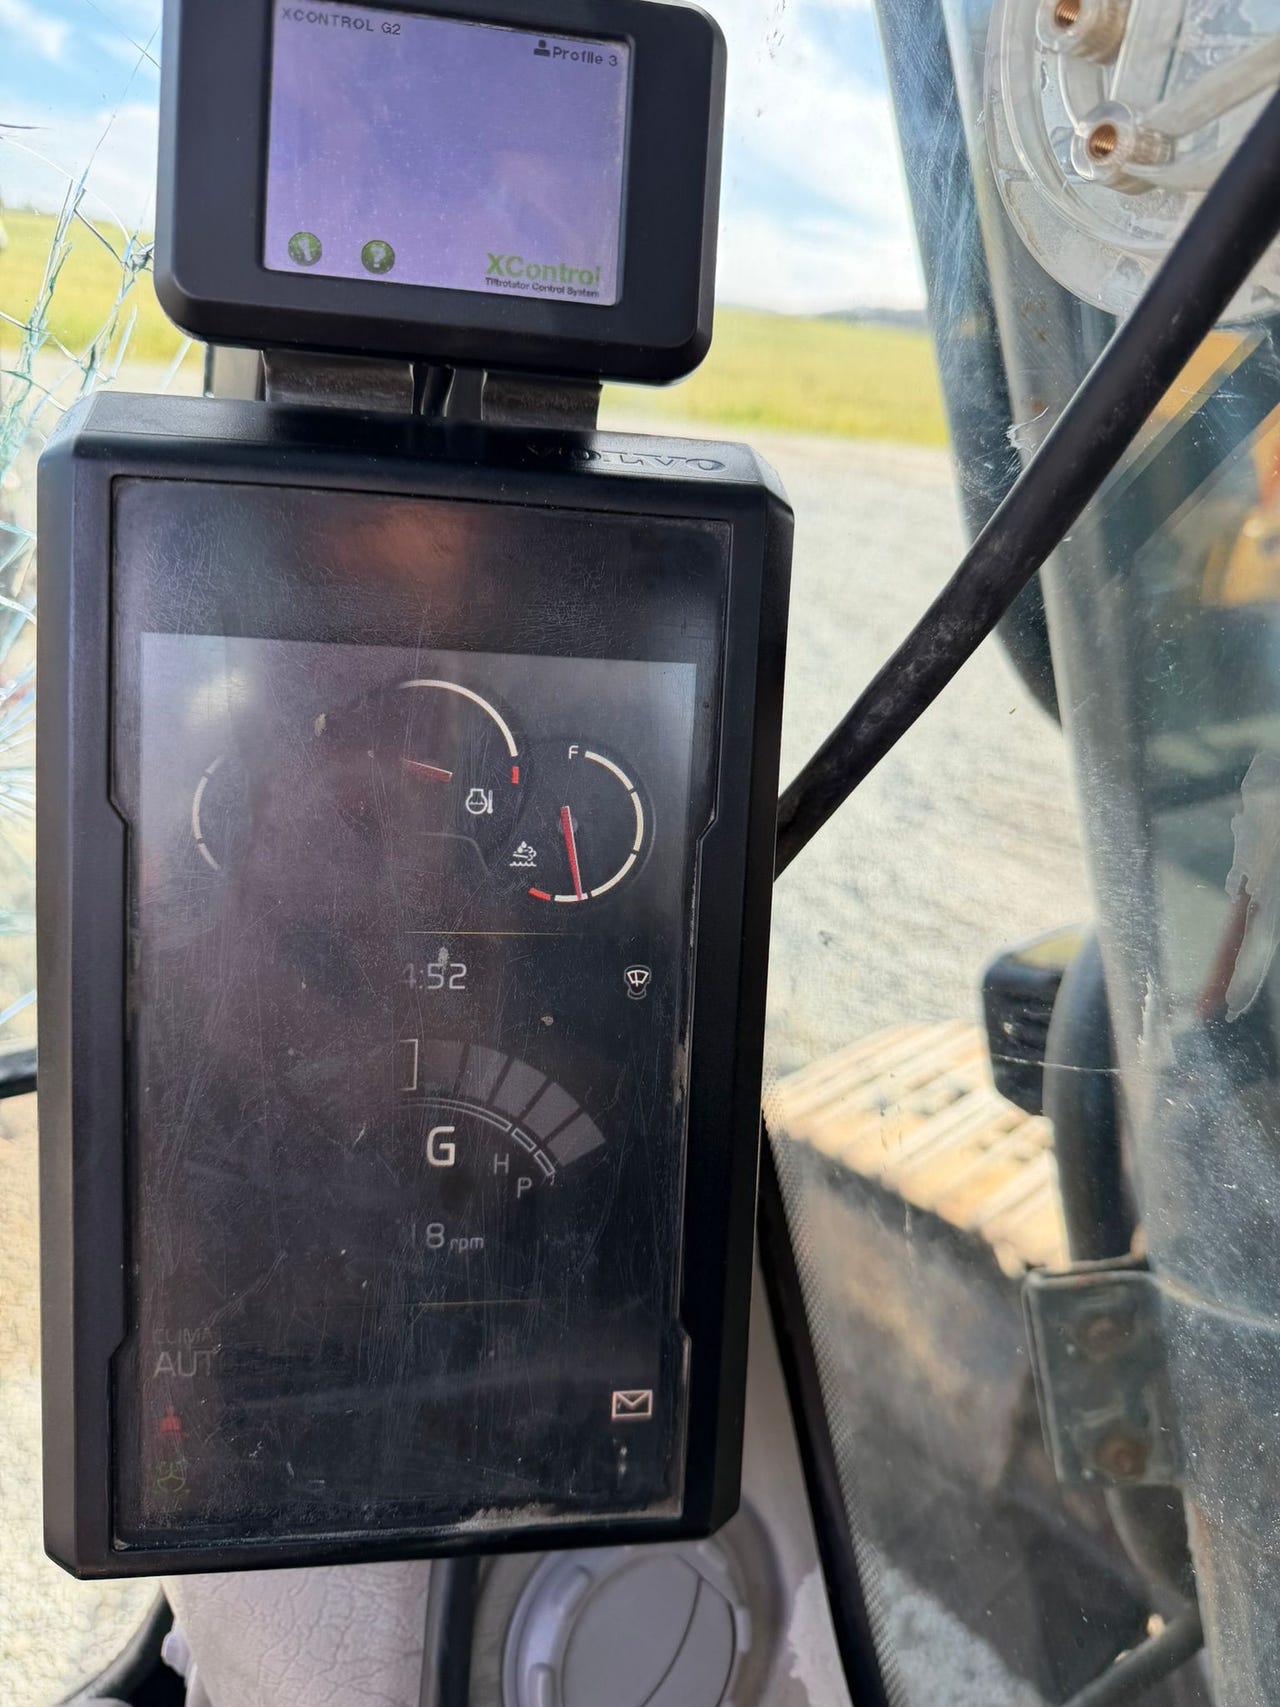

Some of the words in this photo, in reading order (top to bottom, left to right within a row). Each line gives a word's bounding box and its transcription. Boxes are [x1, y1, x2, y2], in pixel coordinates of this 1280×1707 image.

[282, 7, 374, 32] XCONTROL
[381, 21, 401, 36] G2
[552, 46, 603, 65] Profile
[608, 54, 618, 67] 3
[486, 253, 600, 285] XControl
[531, 282, 565, 294] Control
[567, 286, 600, 297] System
[568, 745, 579, 760] F
[426, 1126, 456, 1167] G
[493, 1153, 510, 1175] H
[517, 1177, 532, 1198] P
[450, 1237, 484, 1254] rpm
